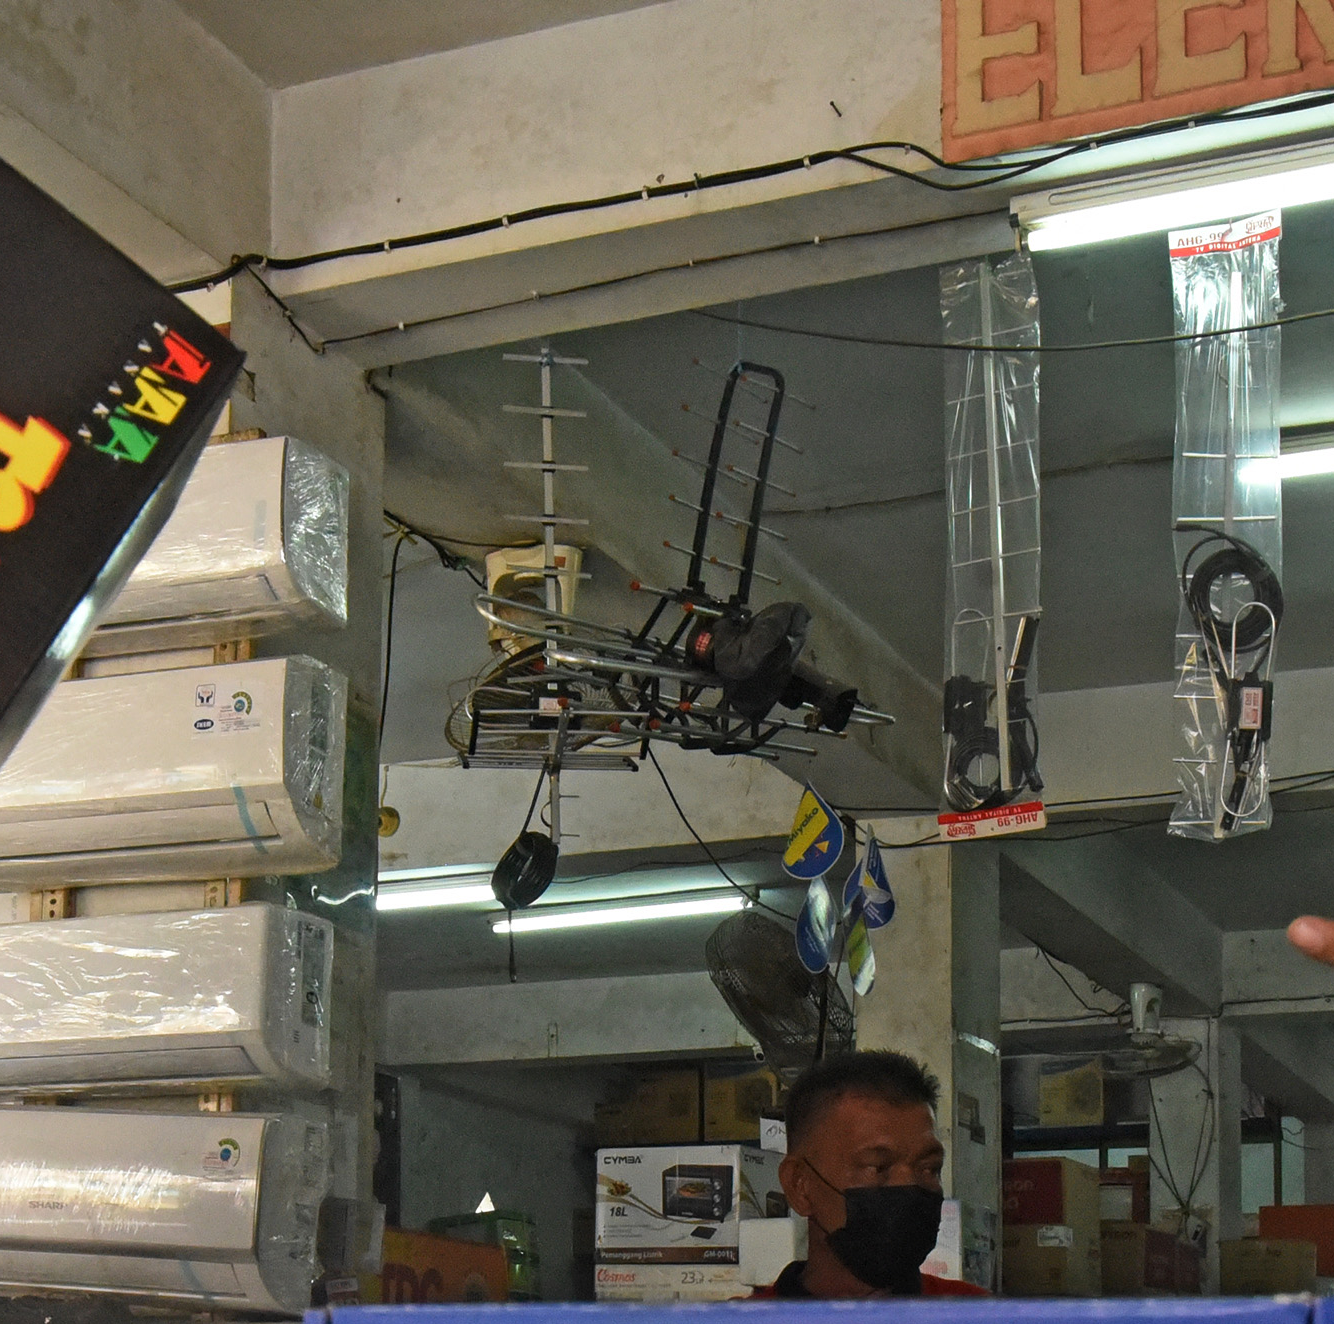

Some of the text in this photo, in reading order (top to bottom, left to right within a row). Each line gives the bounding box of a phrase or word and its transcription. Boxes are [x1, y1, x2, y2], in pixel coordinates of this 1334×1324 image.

[788, 806, 819, 845] Miyako
[997, 813, 1038, 828] AHG-99
[597, 1268, 636, 1283] Cosmos
